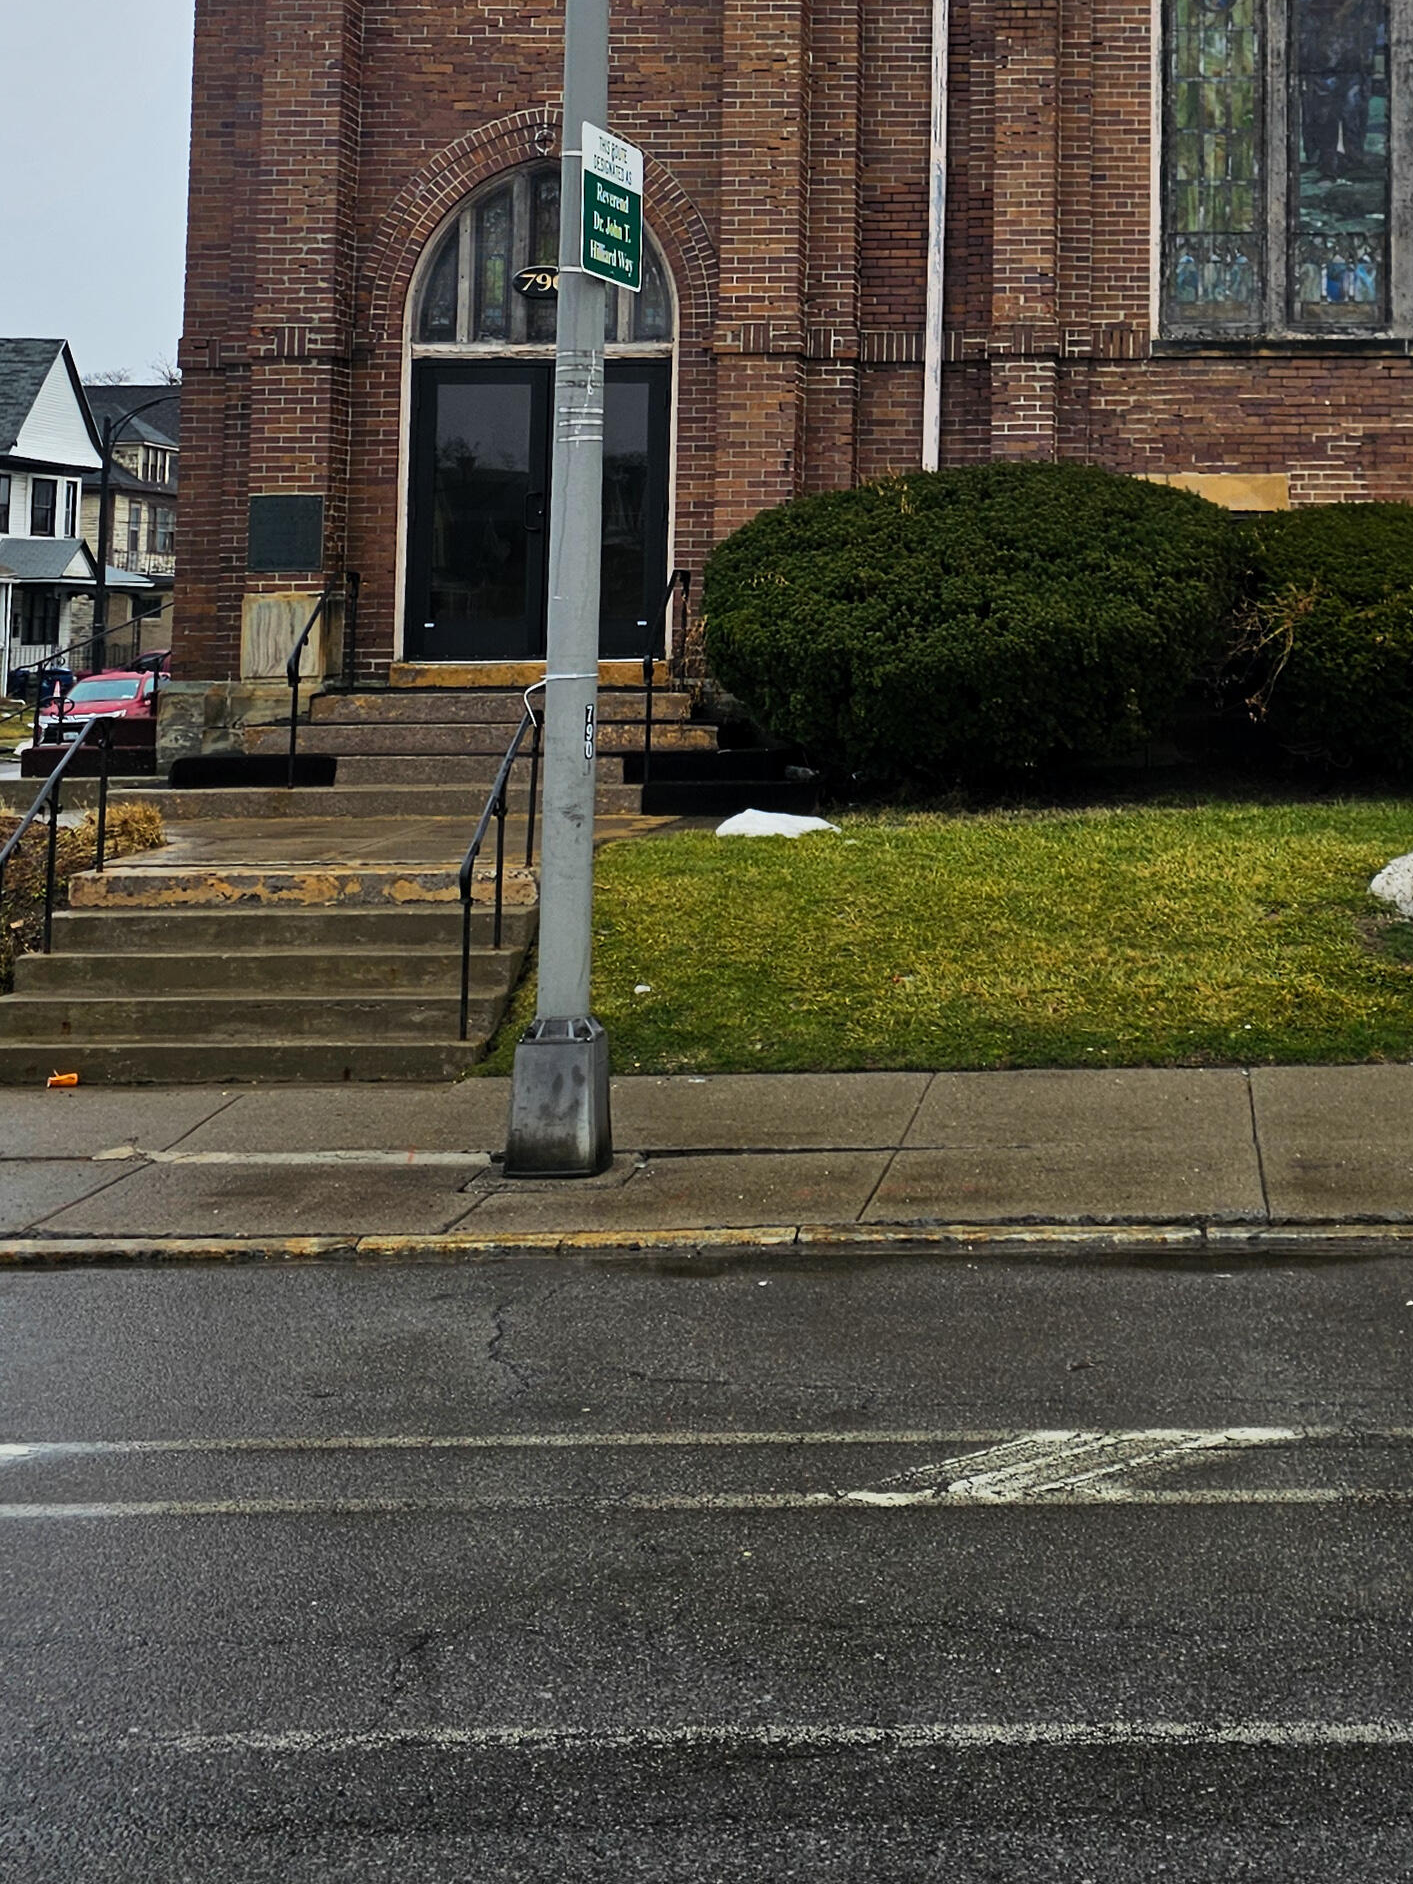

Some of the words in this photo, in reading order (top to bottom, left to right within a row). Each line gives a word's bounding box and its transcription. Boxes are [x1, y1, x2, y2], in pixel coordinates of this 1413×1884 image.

[596, 182, 629, 213] Reverend
[593, 210, 604, 233] Dr.
[605, 216, 622, 240] John
[624, 223, 632, 243] T.
[617, 250, 634, 277] Way
[585, 705, 593, 758] 790
